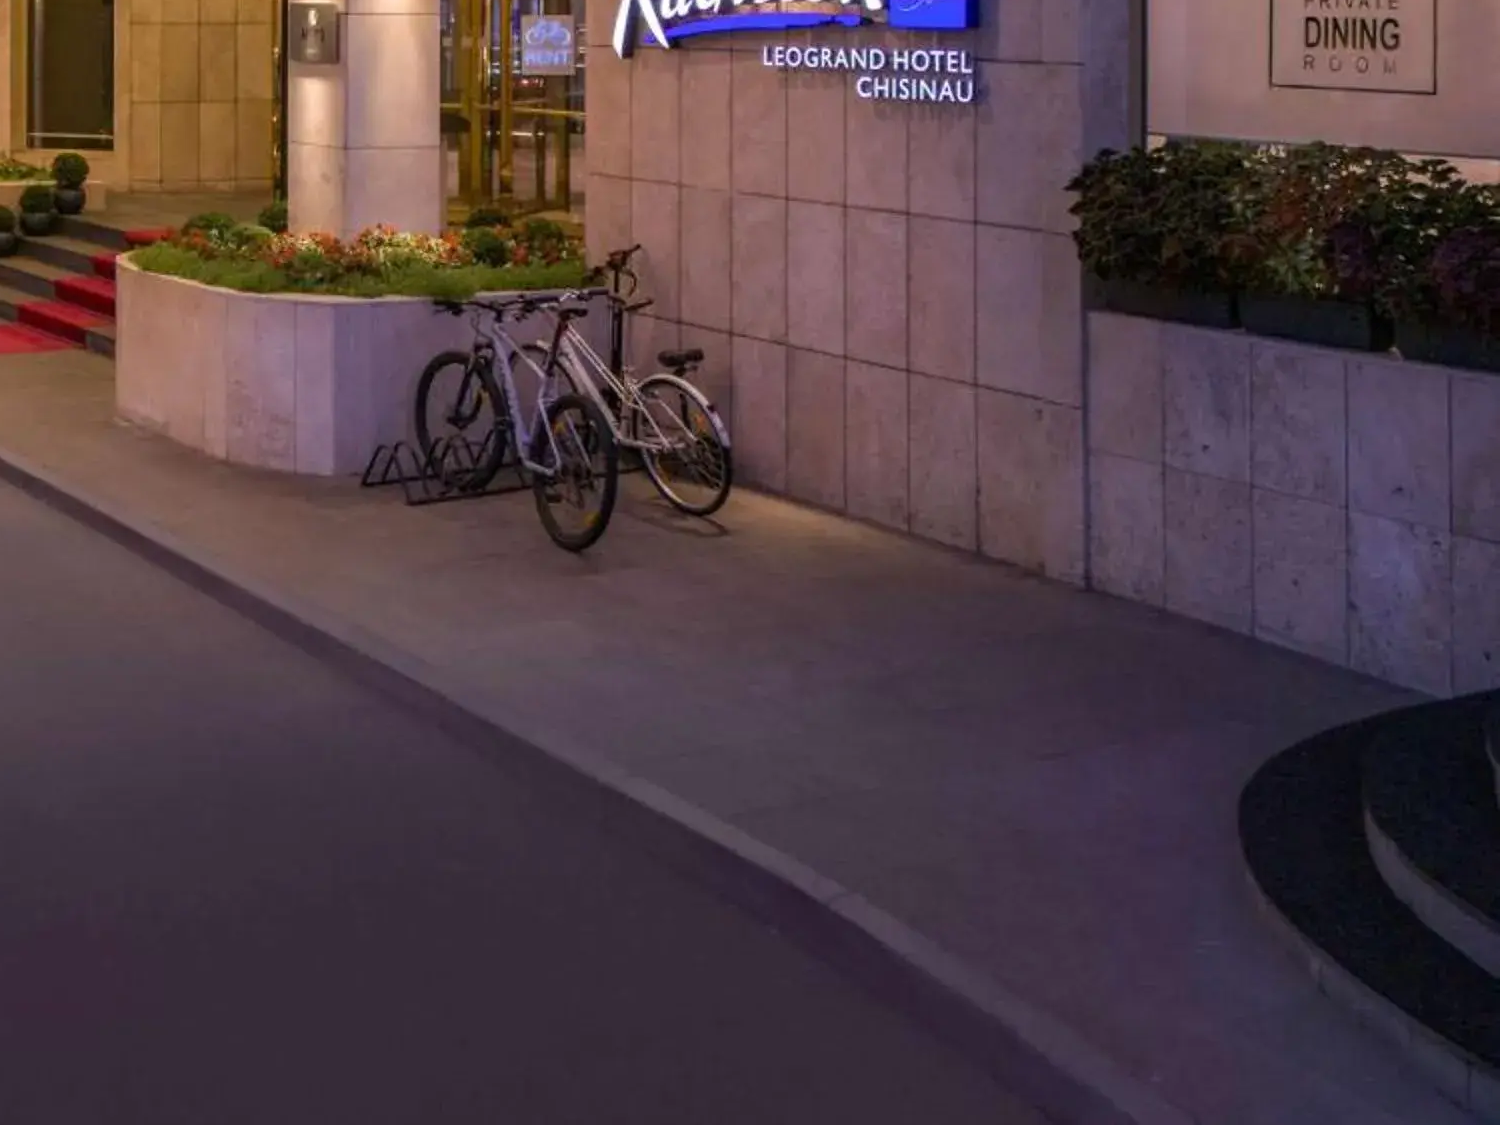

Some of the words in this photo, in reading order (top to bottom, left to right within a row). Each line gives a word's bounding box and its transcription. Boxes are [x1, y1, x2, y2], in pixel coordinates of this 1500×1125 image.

[1304, 15, 1401, 51] DINING
[763, 46, 886, 70] LEOGRAND
[893, 50, 973, 74] HOTEL
[1303, 55, 1398, 75] ROOM
[856, 76, 973, 103] CHISINAU
